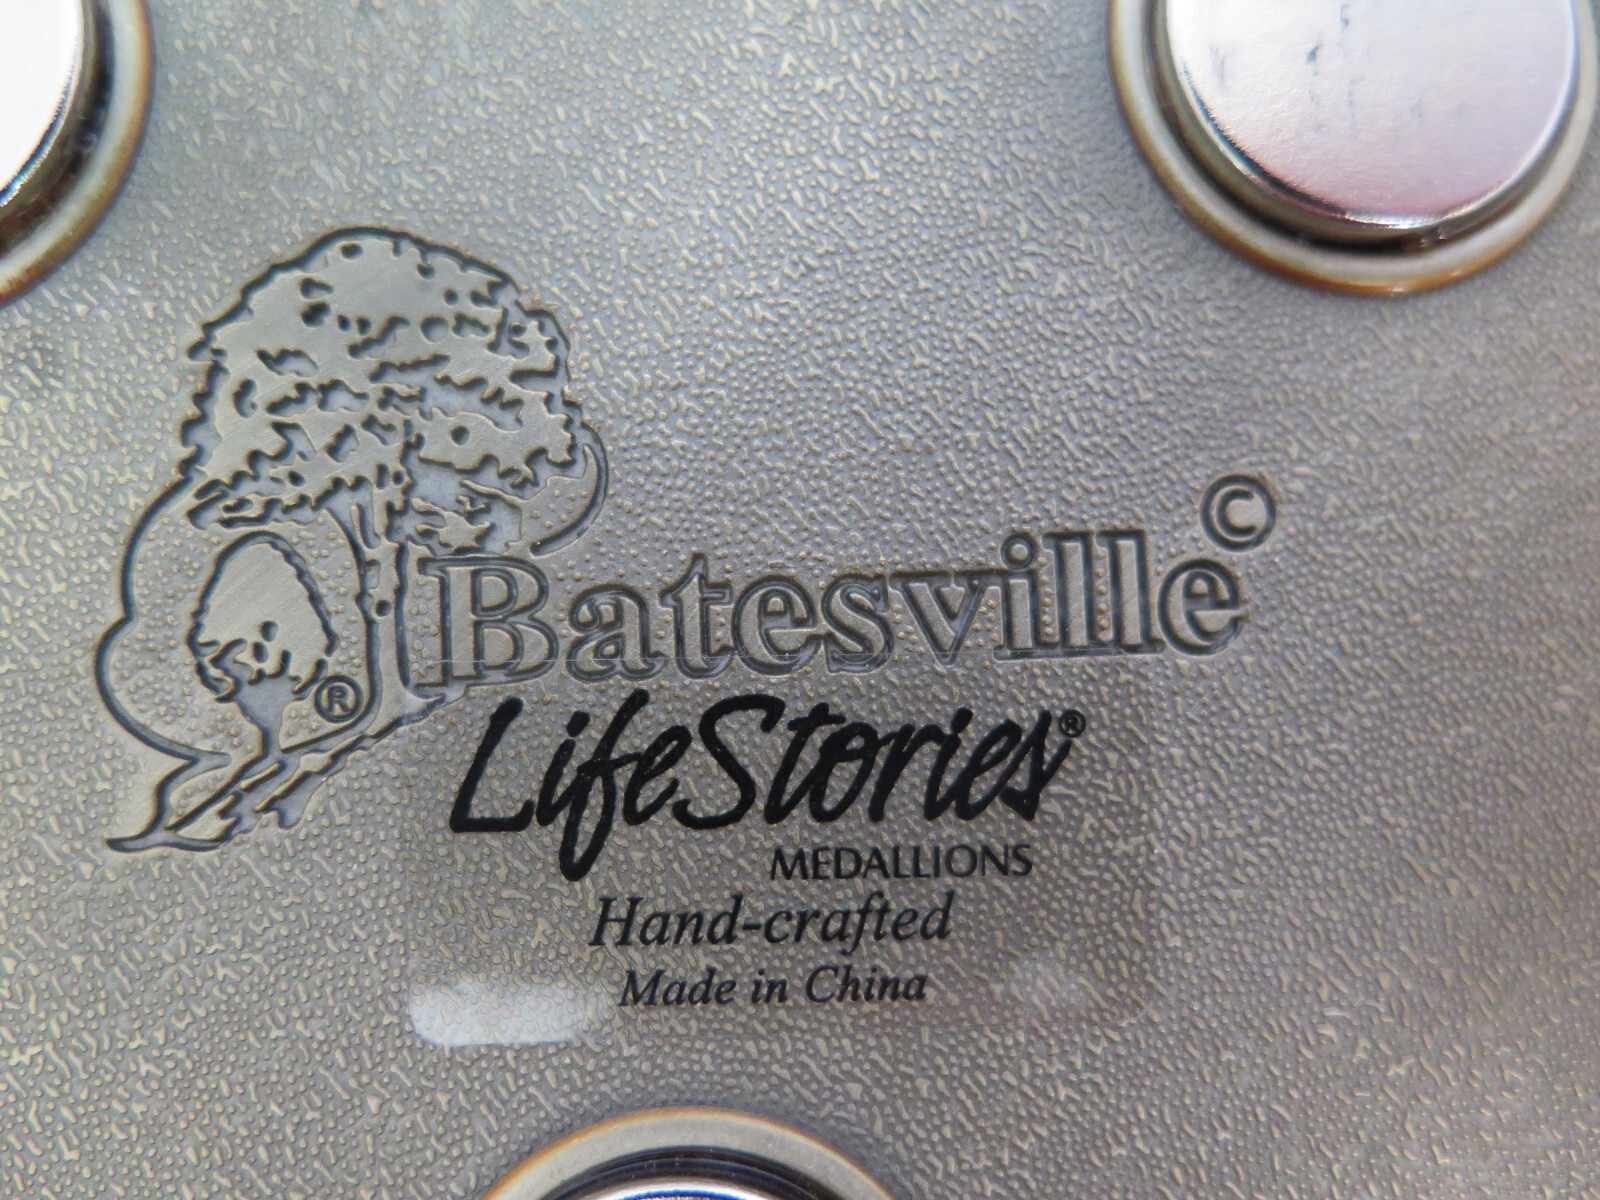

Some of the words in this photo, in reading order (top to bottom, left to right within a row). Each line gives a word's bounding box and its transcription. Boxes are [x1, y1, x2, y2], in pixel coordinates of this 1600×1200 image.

[769, 844, 1034, 880] MEDALLIONS
[589, 890, 954, 955] Hand-crafted
[620, 969, 737, 1007] Made
[750, 968, 789, 1004] in
[805, 965, 929, 1004] China
